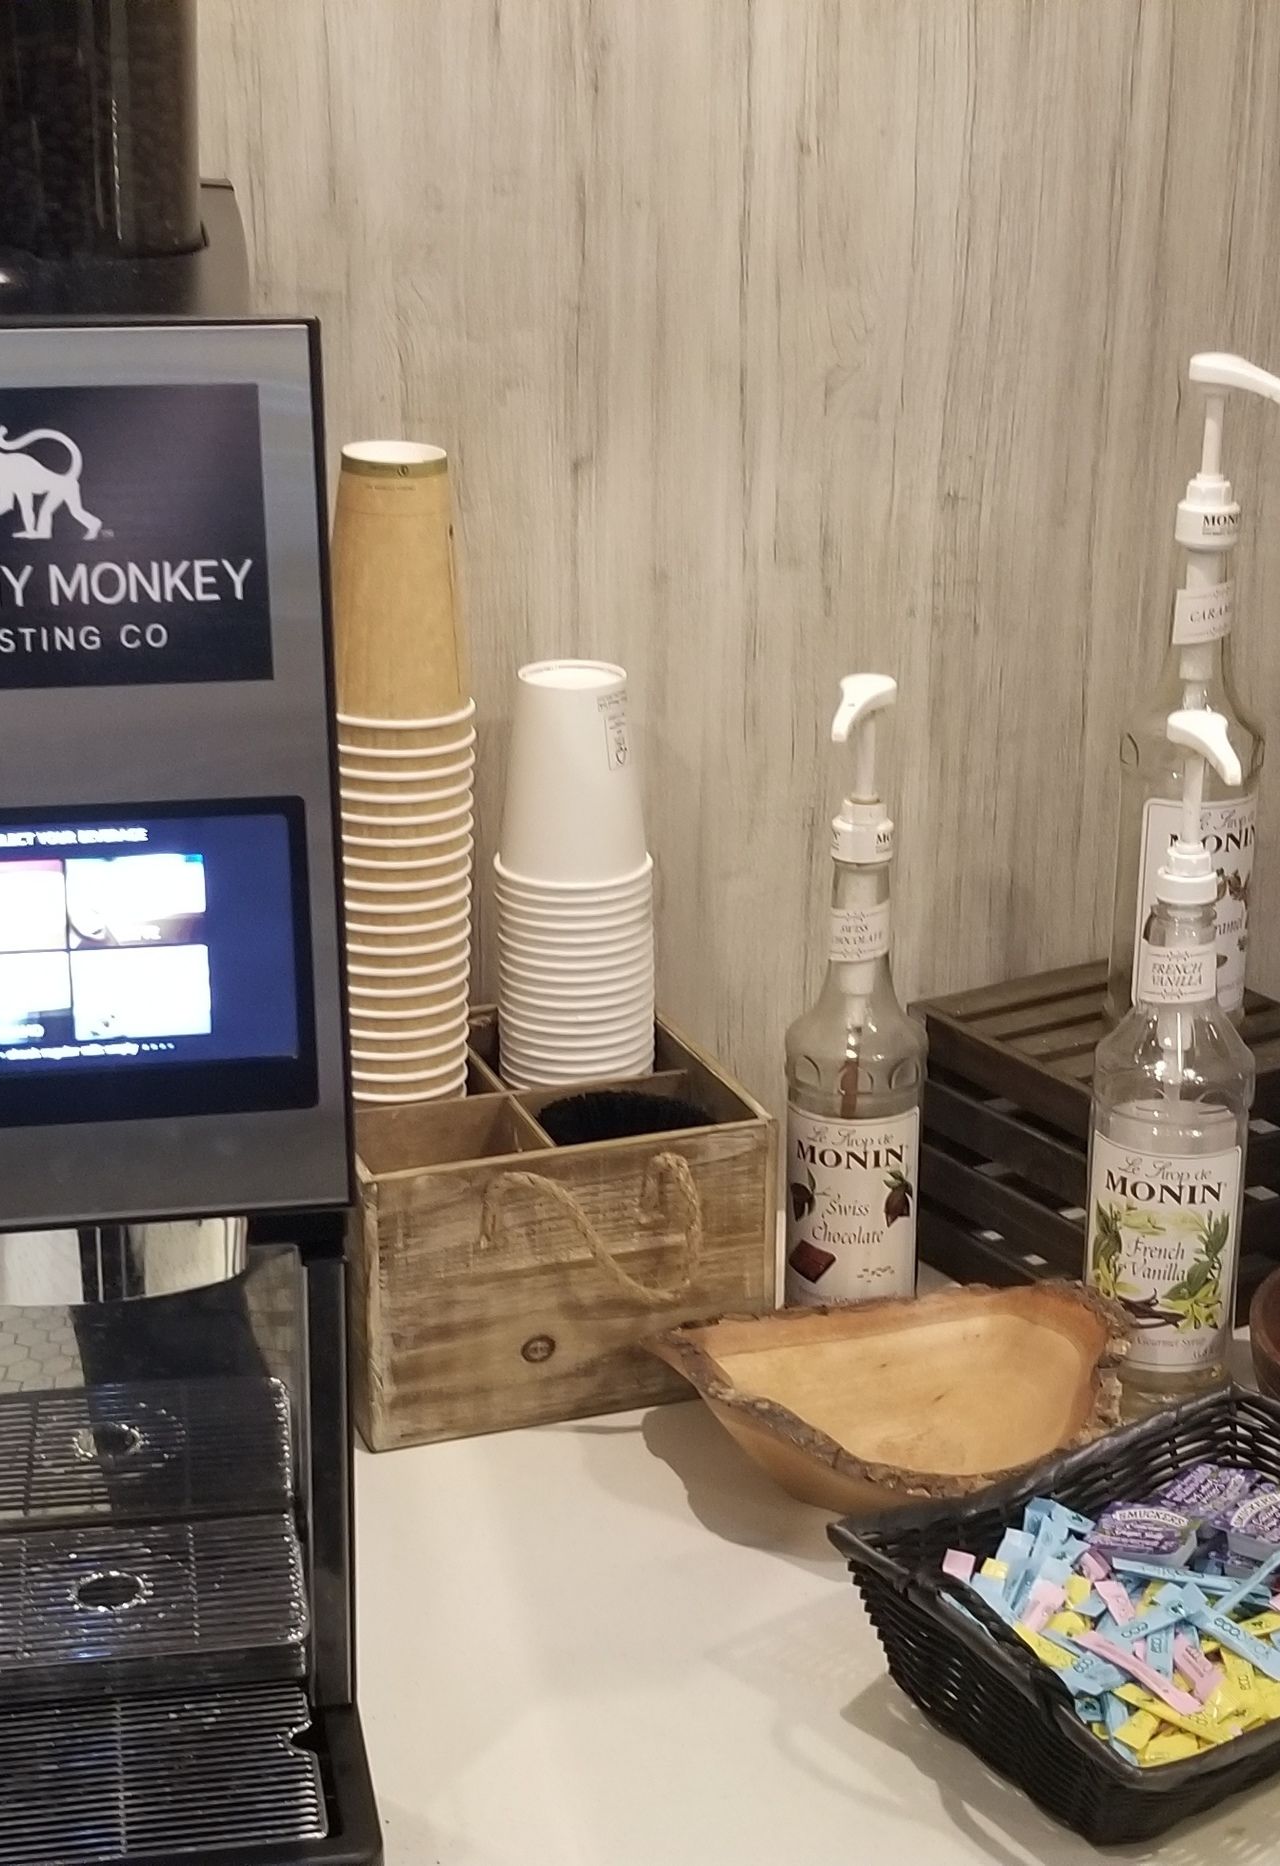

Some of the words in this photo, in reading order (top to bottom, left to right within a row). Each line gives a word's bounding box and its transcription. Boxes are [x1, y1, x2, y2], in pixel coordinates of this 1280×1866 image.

[49, 558, 253, 606] MONKEY
[120, 623, 169, 649] CO
[1152, 961, 1203, 976] FRENCH
[1152, 974, 1202, 987] VANILLA
[796, 1139, 904, 1170] MONIN
[1105, 1168, 1223, 1206] MONIN
[825, 1194, 870, 1217] Swiss
[811, 1217, 884, 1245] Chocolate
[1126, 1235, 1185, 1260] French
[1123, 1258, 1186, 1281] Vanilla
